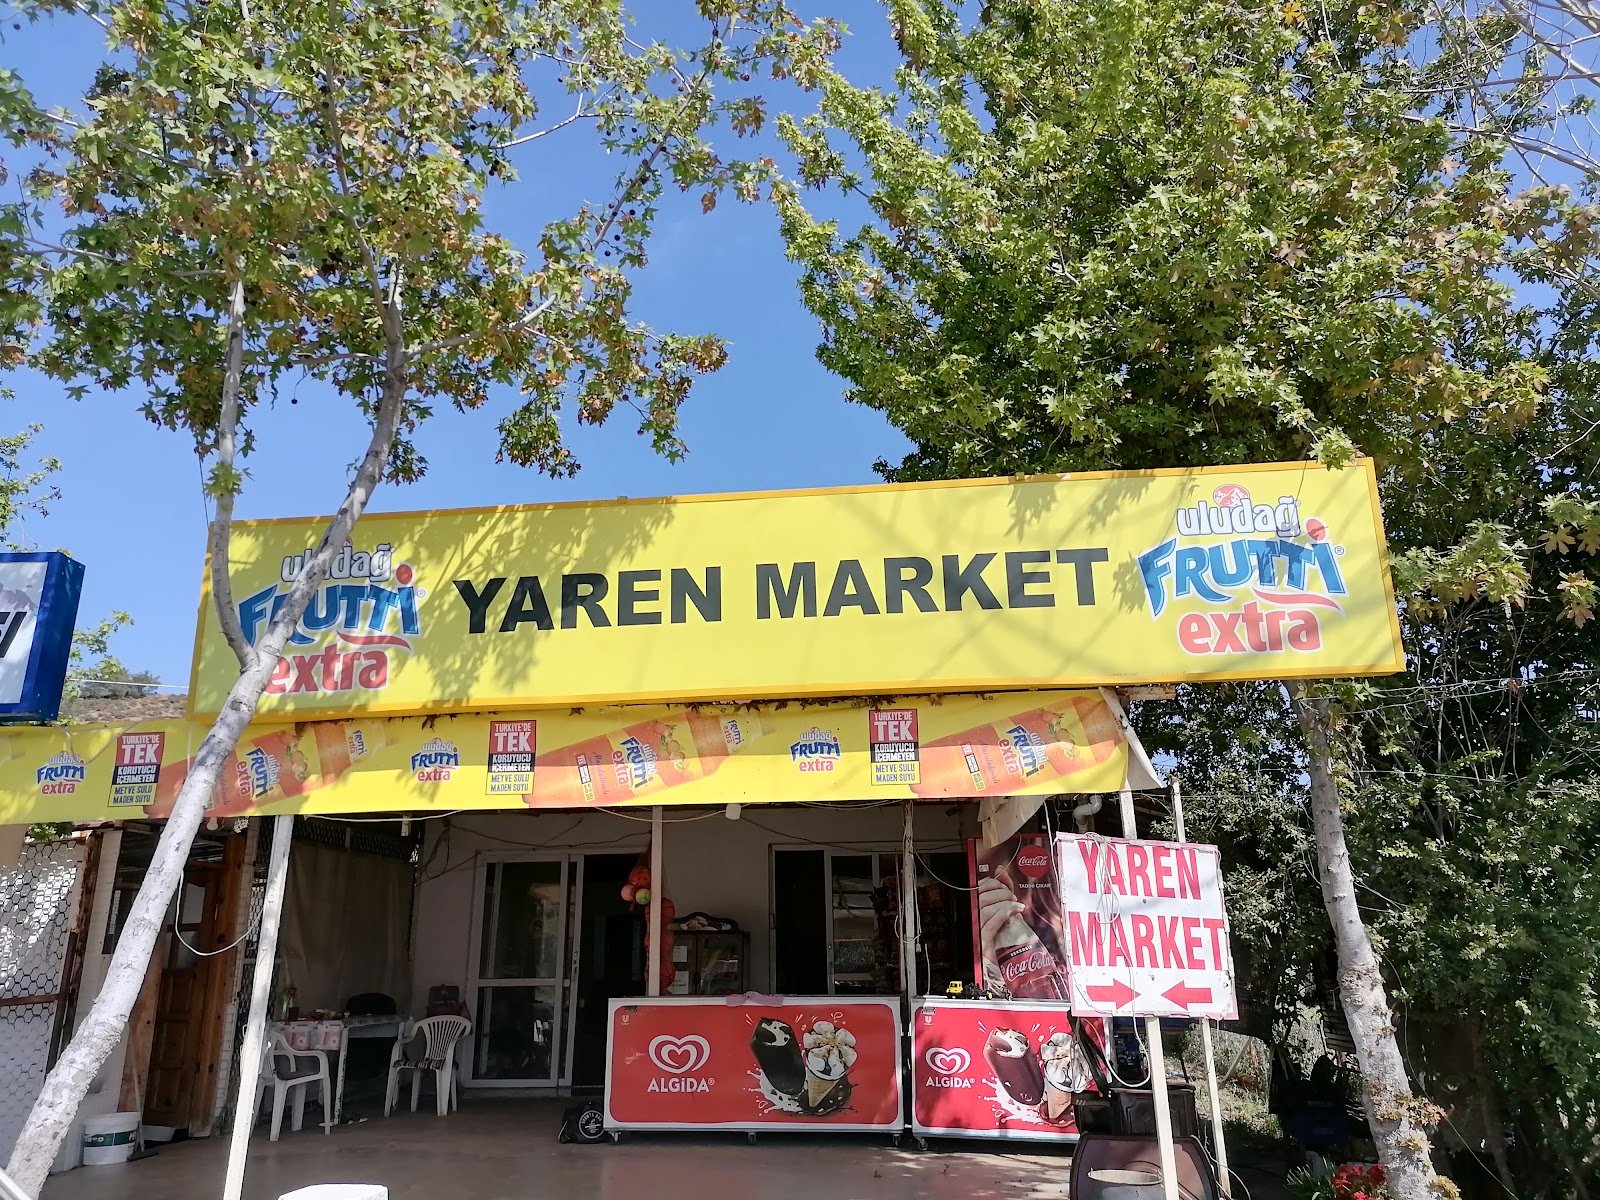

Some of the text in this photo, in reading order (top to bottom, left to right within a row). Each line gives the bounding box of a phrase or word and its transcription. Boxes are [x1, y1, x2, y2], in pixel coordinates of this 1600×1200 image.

[453, 547, 1109, 635] YAREN MARKET
[1178, 601, 1321, 654] extra
[263, 644, 388, 694] extra
[874, 720, 914, 741] TEK
[494, 731, 532, 752] TEK
[874, 743, 915, 752] KORUYUCU
[121, 743, 160, 764] TEK
[492, 753, 532, 763] KORUYUCU
[117, 765, 157, 776] KORUYUCU
[417, 768, 451, 781] extra
[798, 759, 834, 771] extra
[41, 782, 76, 795] extra
[1076, 840, 1202, 900] YAREN
[1068, 911, 1225, 971] MARKET
